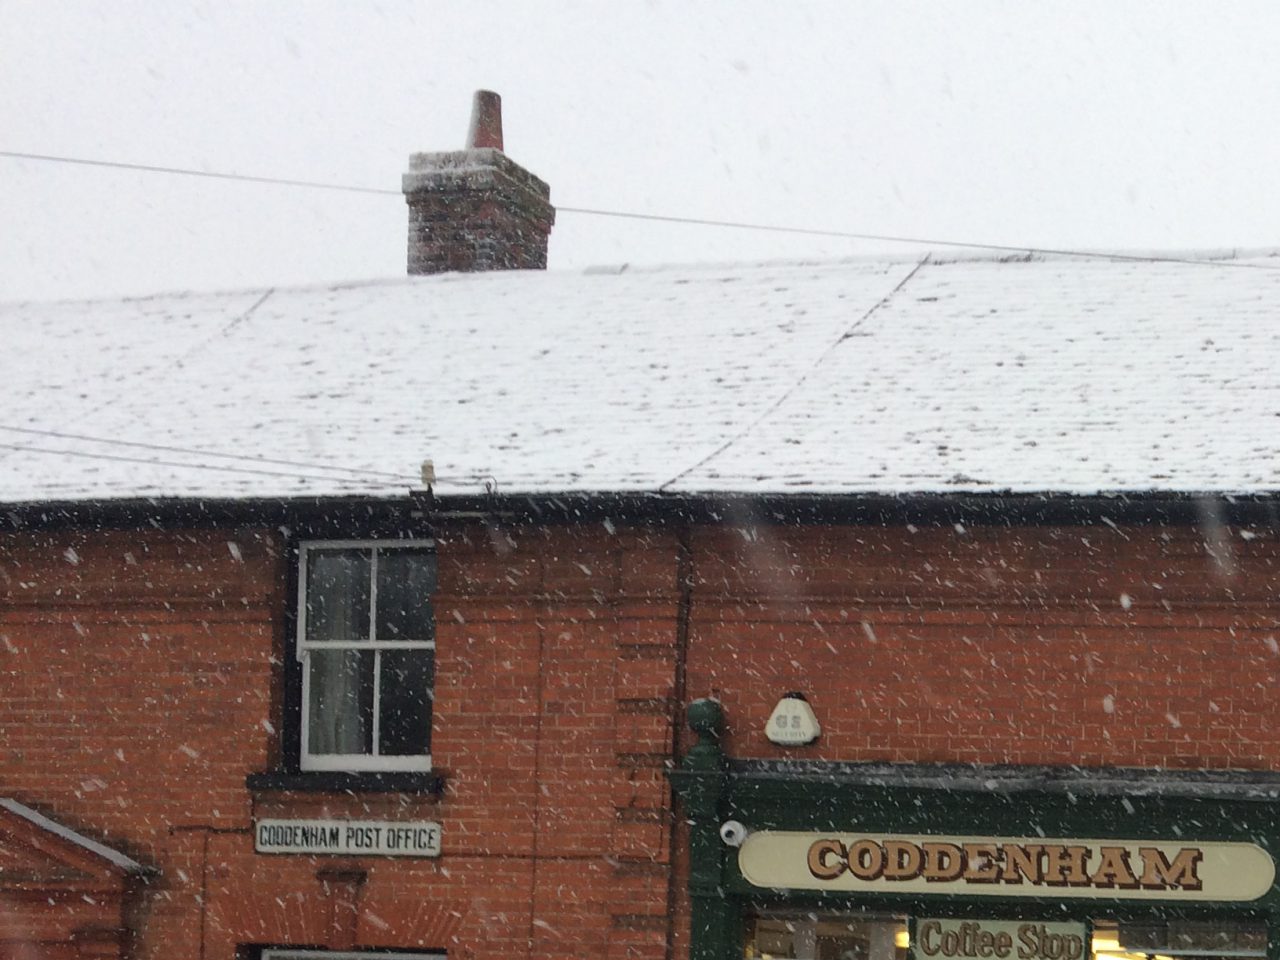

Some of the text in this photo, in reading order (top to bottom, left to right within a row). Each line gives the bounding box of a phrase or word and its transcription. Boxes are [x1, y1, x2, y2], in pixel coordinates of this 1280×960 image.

[259, 825, 437, 850] CODDENHAM POST OFFICE
[807, 838, 1203, 891] CODDENHAM
[919, 921, 1013, 958] Coffee
